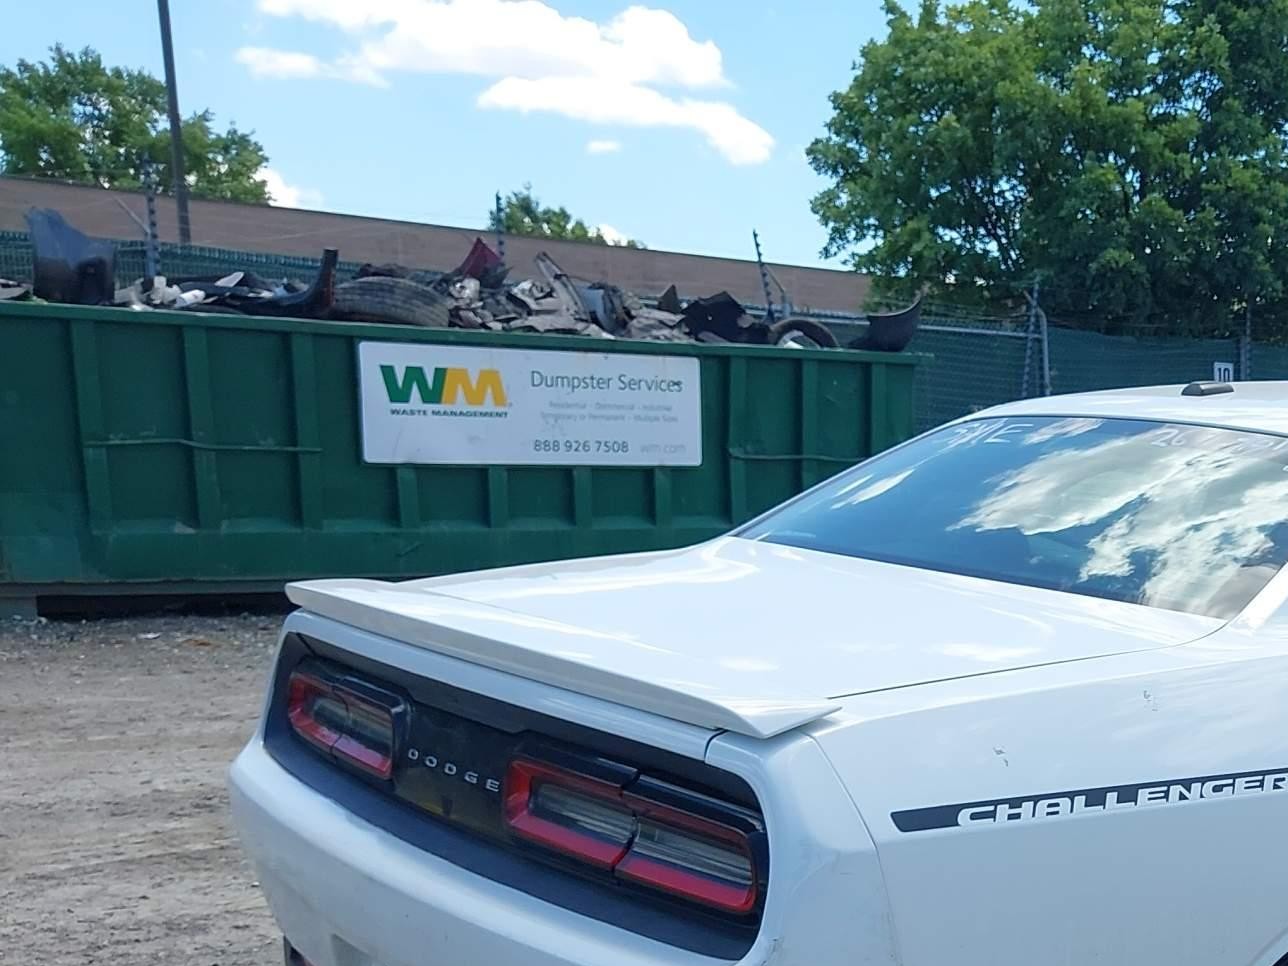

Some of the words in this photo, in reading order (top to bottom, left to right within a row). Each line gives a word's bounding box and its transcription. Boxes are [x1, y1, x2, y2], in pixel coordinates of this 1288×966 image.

[380, 364, 508, 407] WM
[531, 370, 613, 392] Dumpster
[618, 374, 683, 393] Services
[390, 408, 427, 417] WASTE
[431, 409, 508, 418] MANAGEMENT
[534, 439, 561, 452] 888
[564, 440, 591, 452] 926
[595, 440, 629, 453] 7508
[408, 748, 500, 792] DODGE
